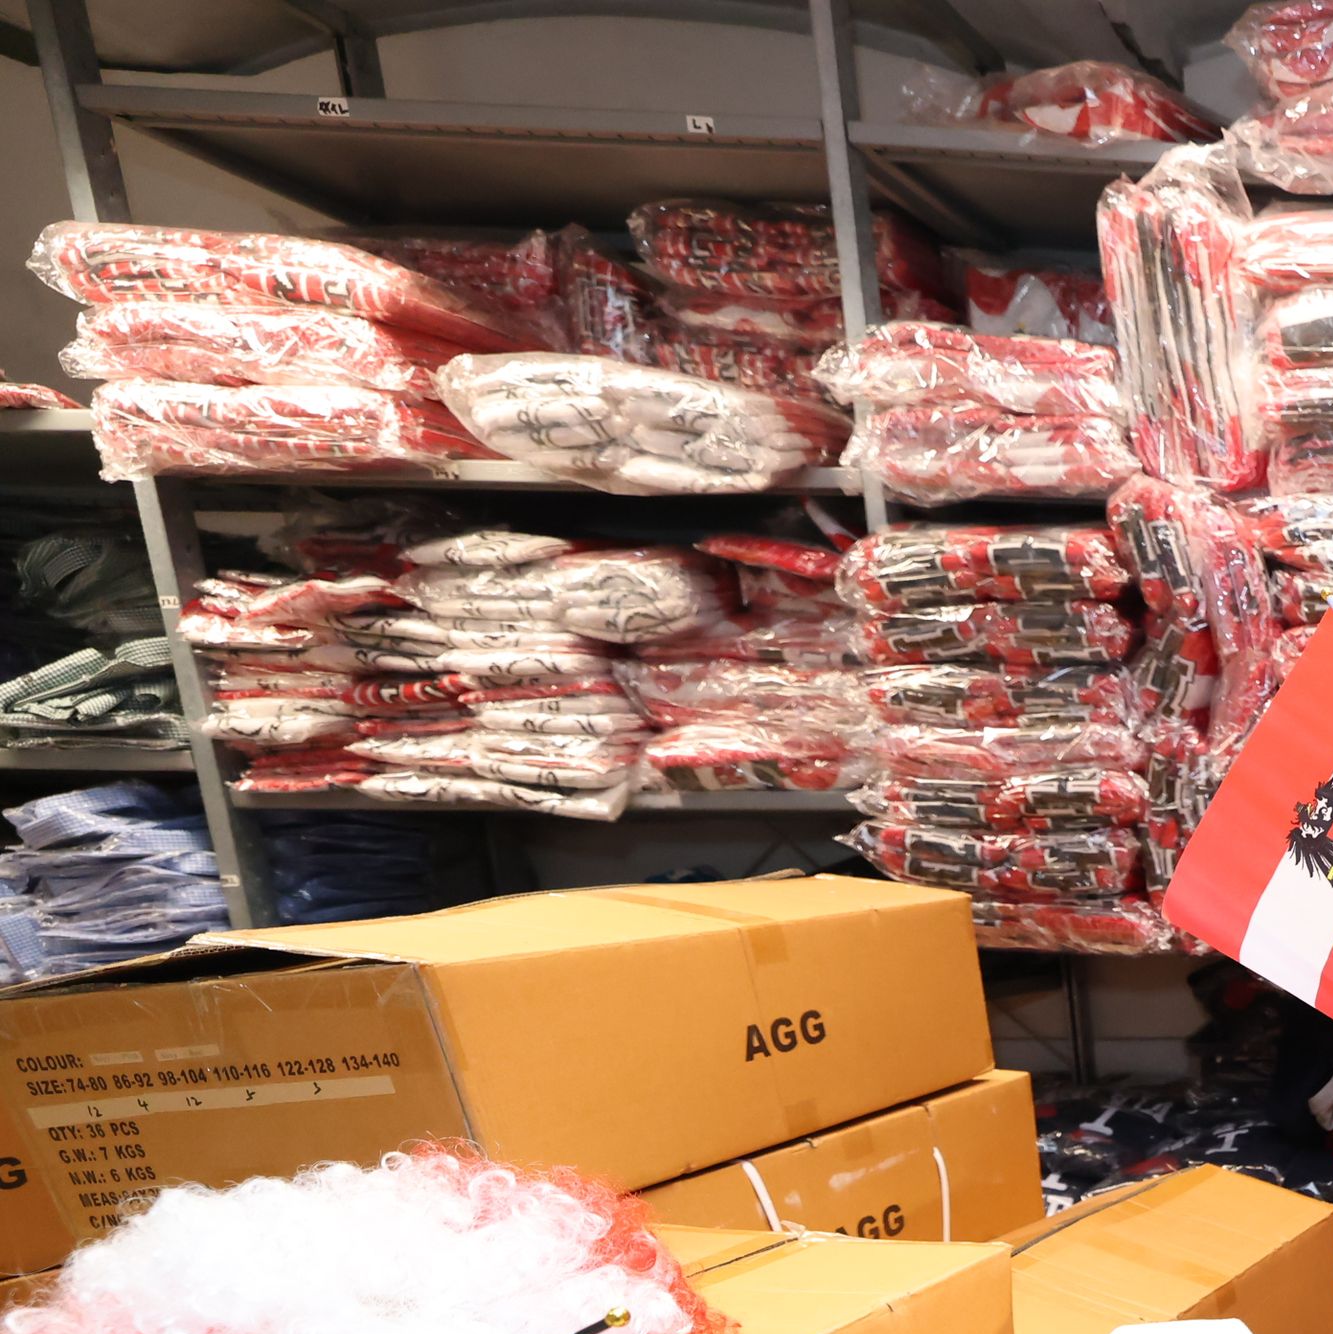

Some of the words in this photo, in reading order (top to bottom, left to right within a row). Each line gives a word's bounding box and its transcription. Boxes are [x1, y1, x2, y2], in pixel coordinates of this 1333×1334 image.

[746, 1010, 826, 1062] AGG
[277, 1058, 335, 1076] 122-128
[342, 1053, 400, 1071] 134-140
